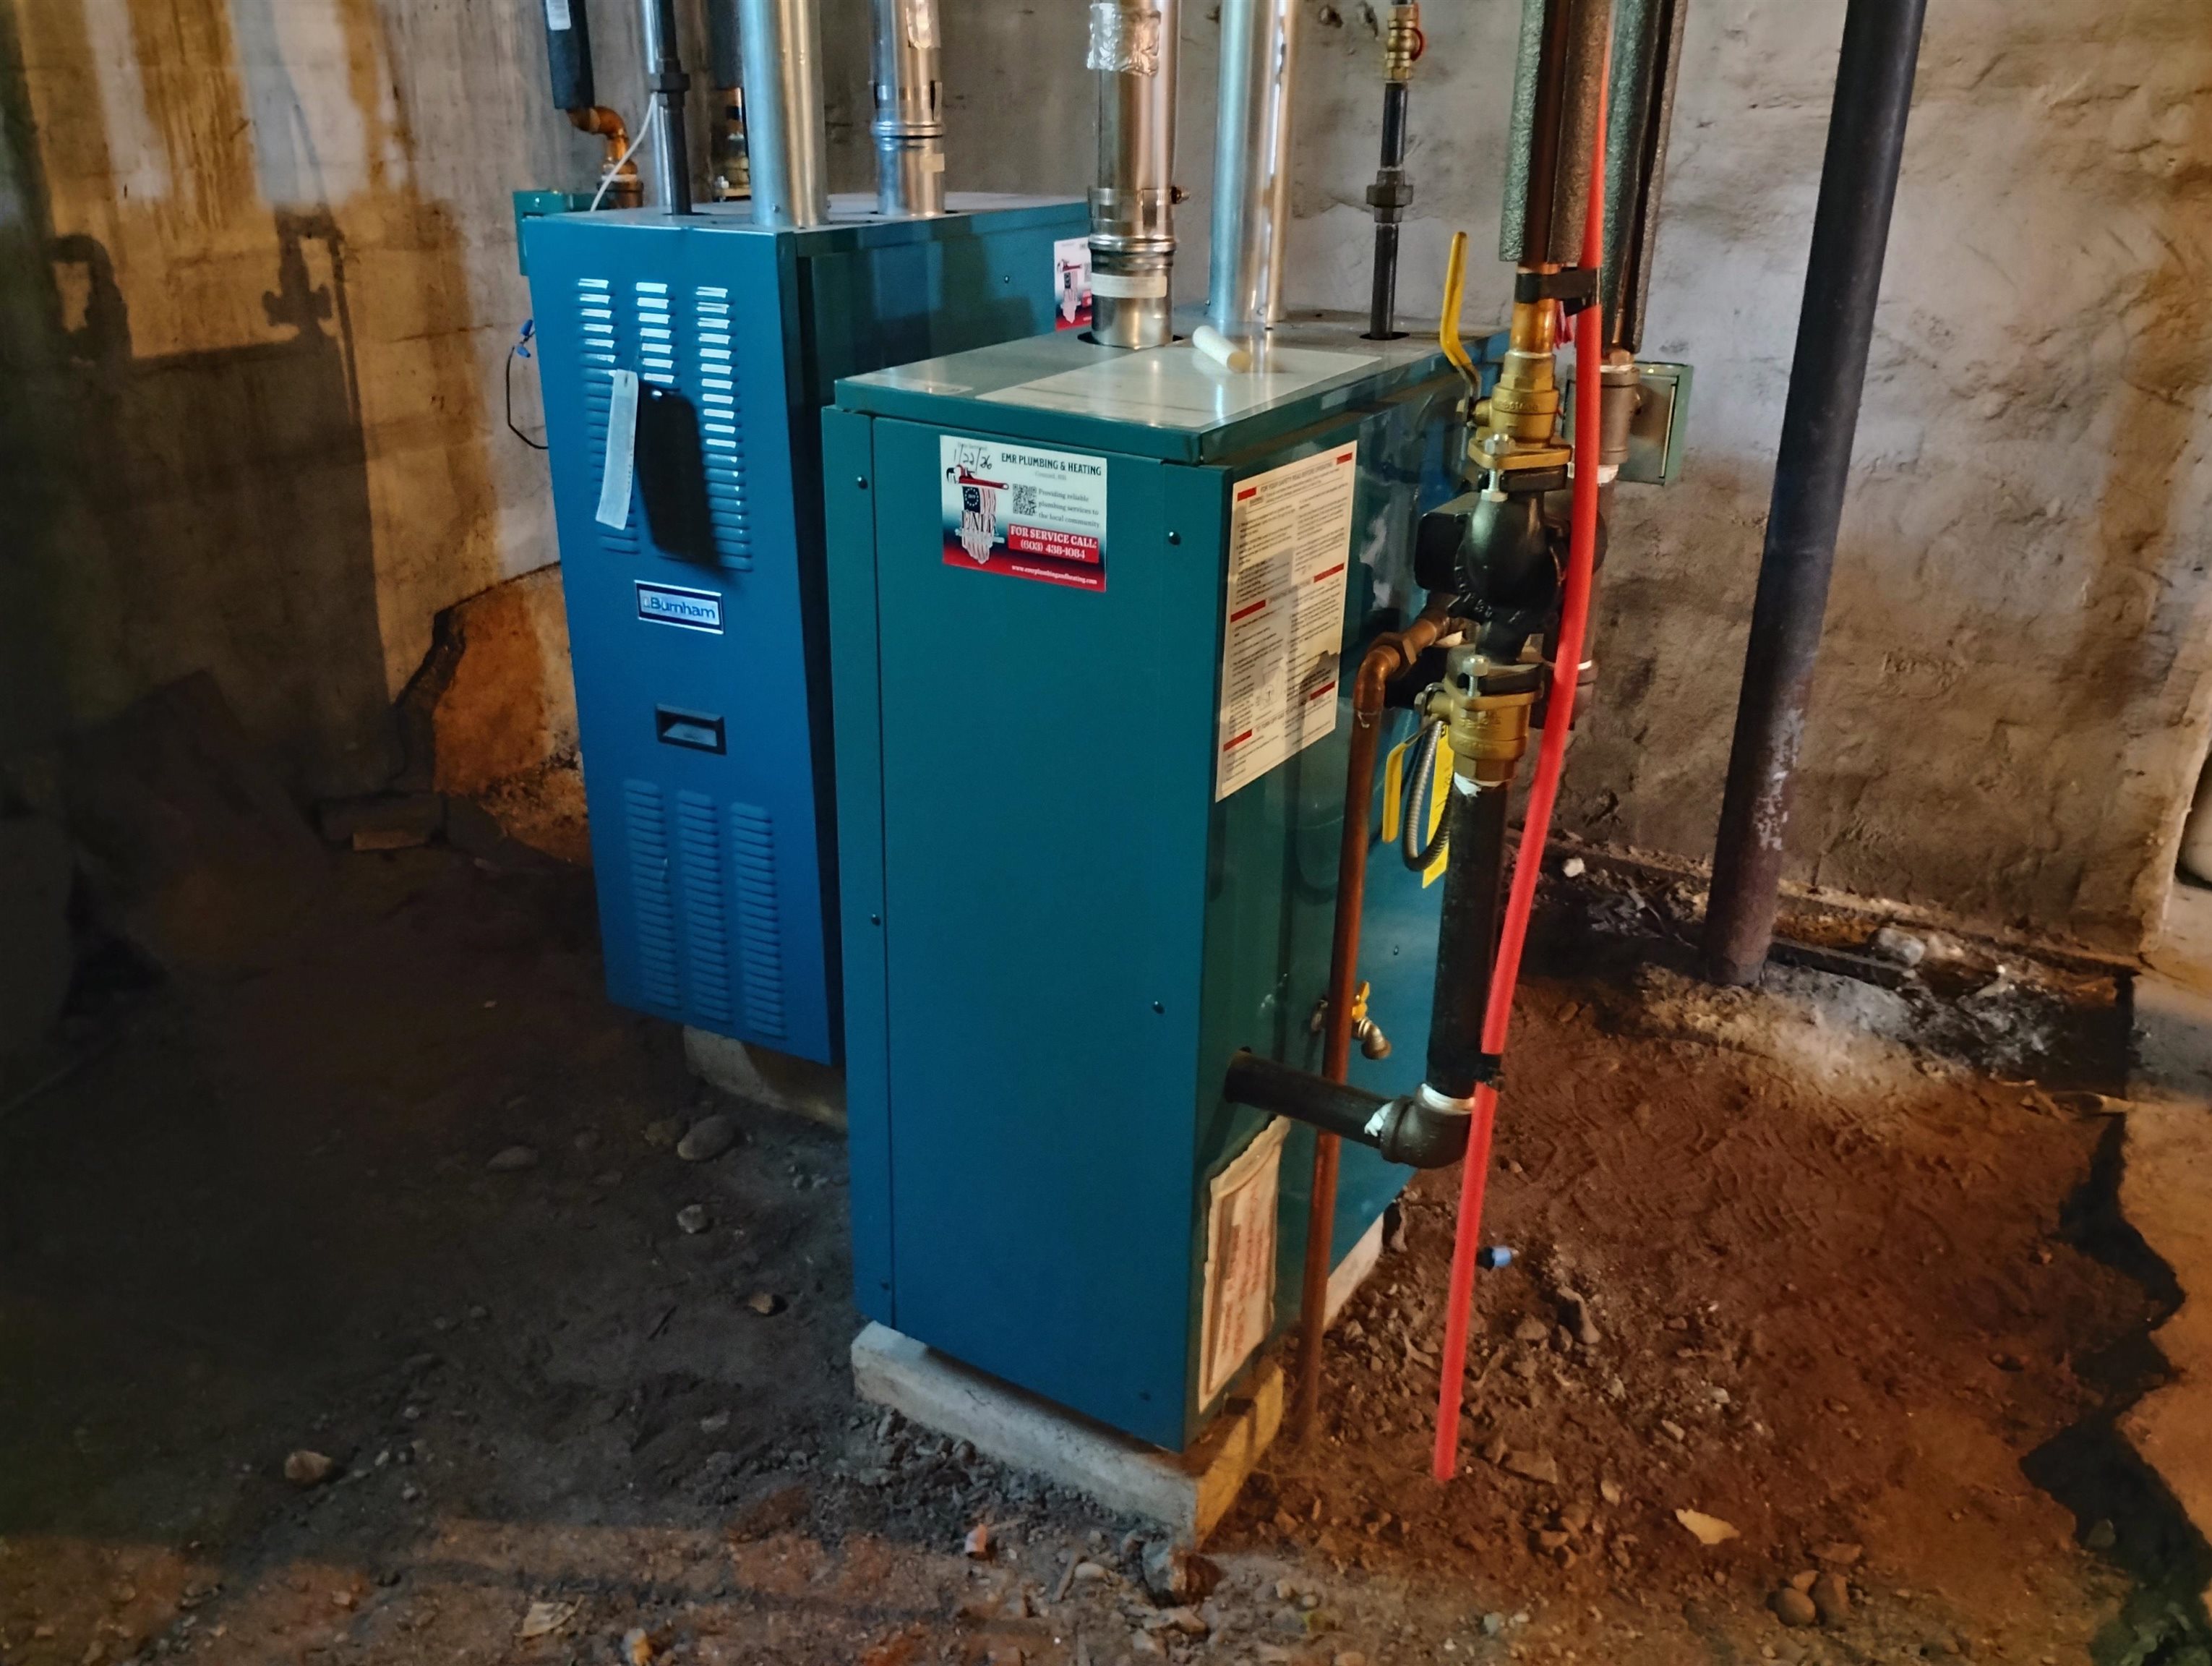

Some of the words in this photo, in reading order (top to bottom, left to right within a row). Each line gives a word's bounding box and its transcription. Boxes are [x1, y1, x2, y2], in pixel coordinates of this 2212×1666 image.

[1001, 453, 1016, 464] EMR
[1019, 455, 1058, 470] PLUMBING
[1060, 461, 1066, 471] &
[1068, 461, 1102, 476] HEATING
[1039, 488, 1066, 500] Providing
[1067, 492, 1089, 502] reliable
[1039, 501, 1066, 511] plumbing
[1067, 505, 1092, 514] services
[1065, 517, 1099, 528] community
[1011, 525, 1029, 537] FOR
[1030, 528, 1069, 544] SERVICE
[1071, 535, 1097, 549] CALL:
[1020, 539, 1043, 552] (603)
[1045, 544, 1086, 559] 438-1084
[651, 597, 716, 620] Burnham
